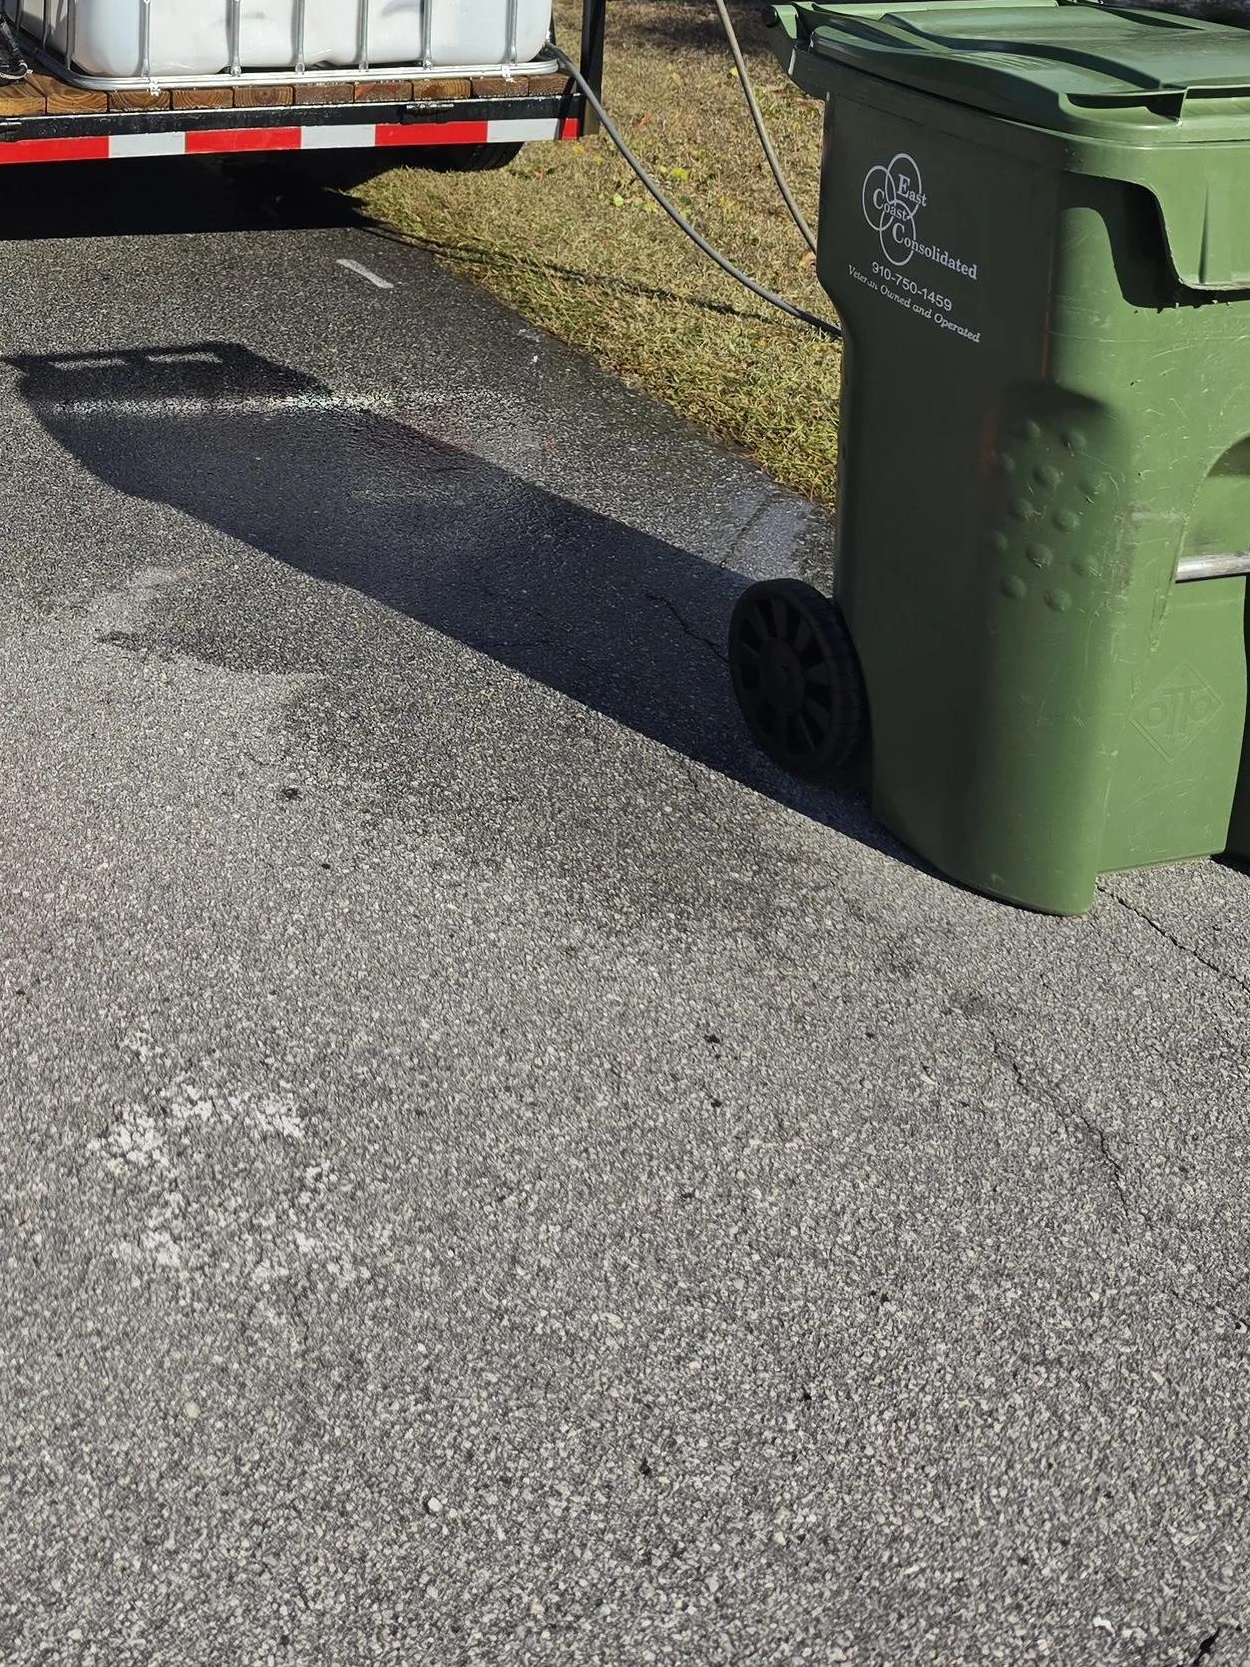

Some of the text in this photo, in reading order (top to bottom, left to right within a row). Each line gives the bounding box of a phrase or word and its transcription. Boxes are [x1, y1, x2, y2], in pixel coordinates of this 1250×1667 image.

[873, 188, 908, 222] Coast
[897, 174, 927, 207] East
[892, 222, 978, 280] Consolidated
[872, 261, 952, 311] 910-750-1459
[880, 284, 911, 309] Owned
[912, 304, 933, 319] and
[934, 313, 981, 343] Operated
